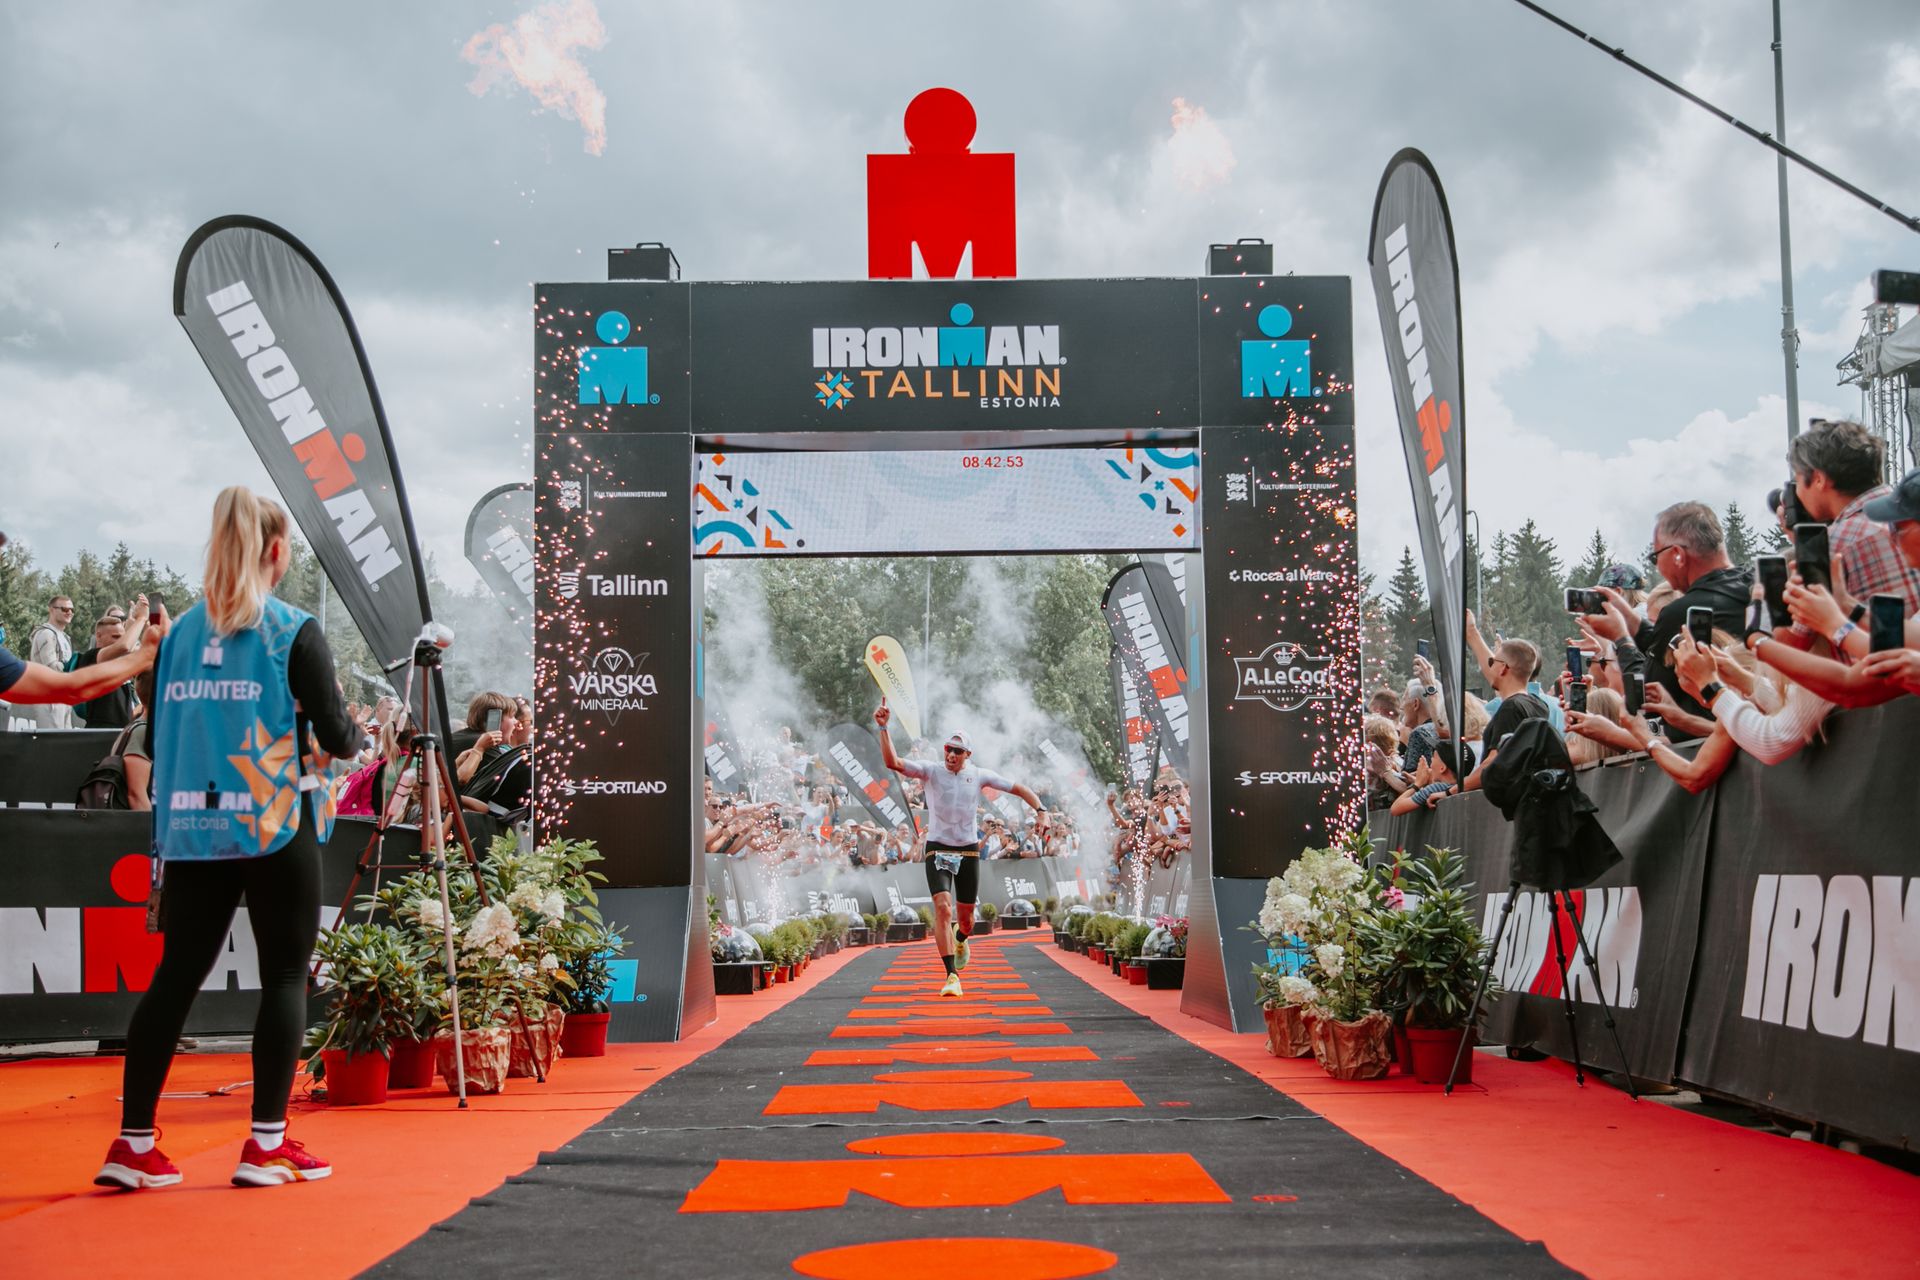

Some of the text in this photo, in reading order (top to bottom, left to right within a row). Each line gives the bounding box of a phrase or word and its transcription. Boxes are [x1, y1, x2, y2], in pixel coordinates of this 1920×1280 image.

[813, 302, 1060, 368] IRONMAN
[861, 368, 1061, 399] TALLINN
[1384, 223, 1462, 571] IRONMAN
[980, 396, 1061, 409] ESTONIA
[206, 280, 402, 588] IRONMAN
[962, 455, 1024, 468] 08:42:53
[486, 524, 536, 609] IRO
[1242, 568, 1334, 582] Rocca al Mare
[586, 574, 668, 597] Tallinn
[1118, 591, 1189, 744] IRONMAN
[568, 671, 659, 698] VÄRSKA
[580, 698, 648, 711] MINERAAL
[583, 781, 667, 794] SPORTLAND
[829, 741, 908, 828] IRONMAN
[1260, 771, 1341, 784] SPORTLAND
[829, 893, 859, 913] allinn
[1479, 885, 1642, 1008] IRONMAN
